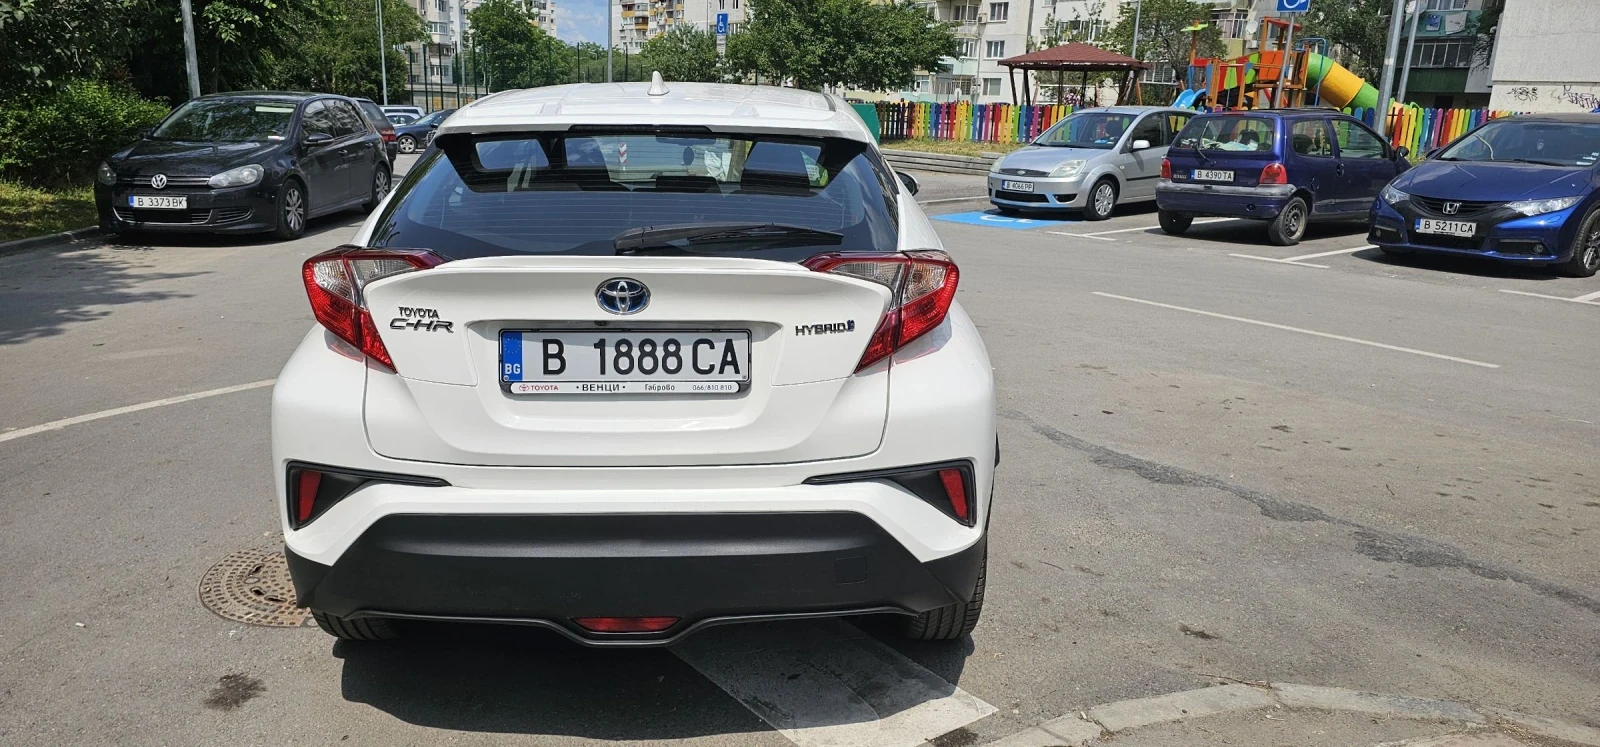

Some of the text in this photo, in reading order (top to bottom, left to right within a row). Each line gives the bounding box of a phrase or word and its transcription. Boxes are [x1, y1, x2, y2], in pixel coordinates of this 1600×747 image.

[1205, 171, 1222, 179] 4390
[1223, 172, 1232, 180] TA
[1012, 182, 1024, 190] 4066
[148, 197, 170, 207] 3373
[172, 198, 184, 207] BK
[1435, 221, 1457, 232] 5211
[1460, 223, 1473, 233] CA
[398, 306, 440, 319] TOYOTA
[389, 318, 454, 333] C-HR
[795, 323, 846, 336] HYBRID
[542, 338, 741, 375] B 1888 CA
[504, 363, 521, 375] BG
[582, 384, 620, 392] ВЕНЦИ
[644, 384, 675, 392] Габрово
